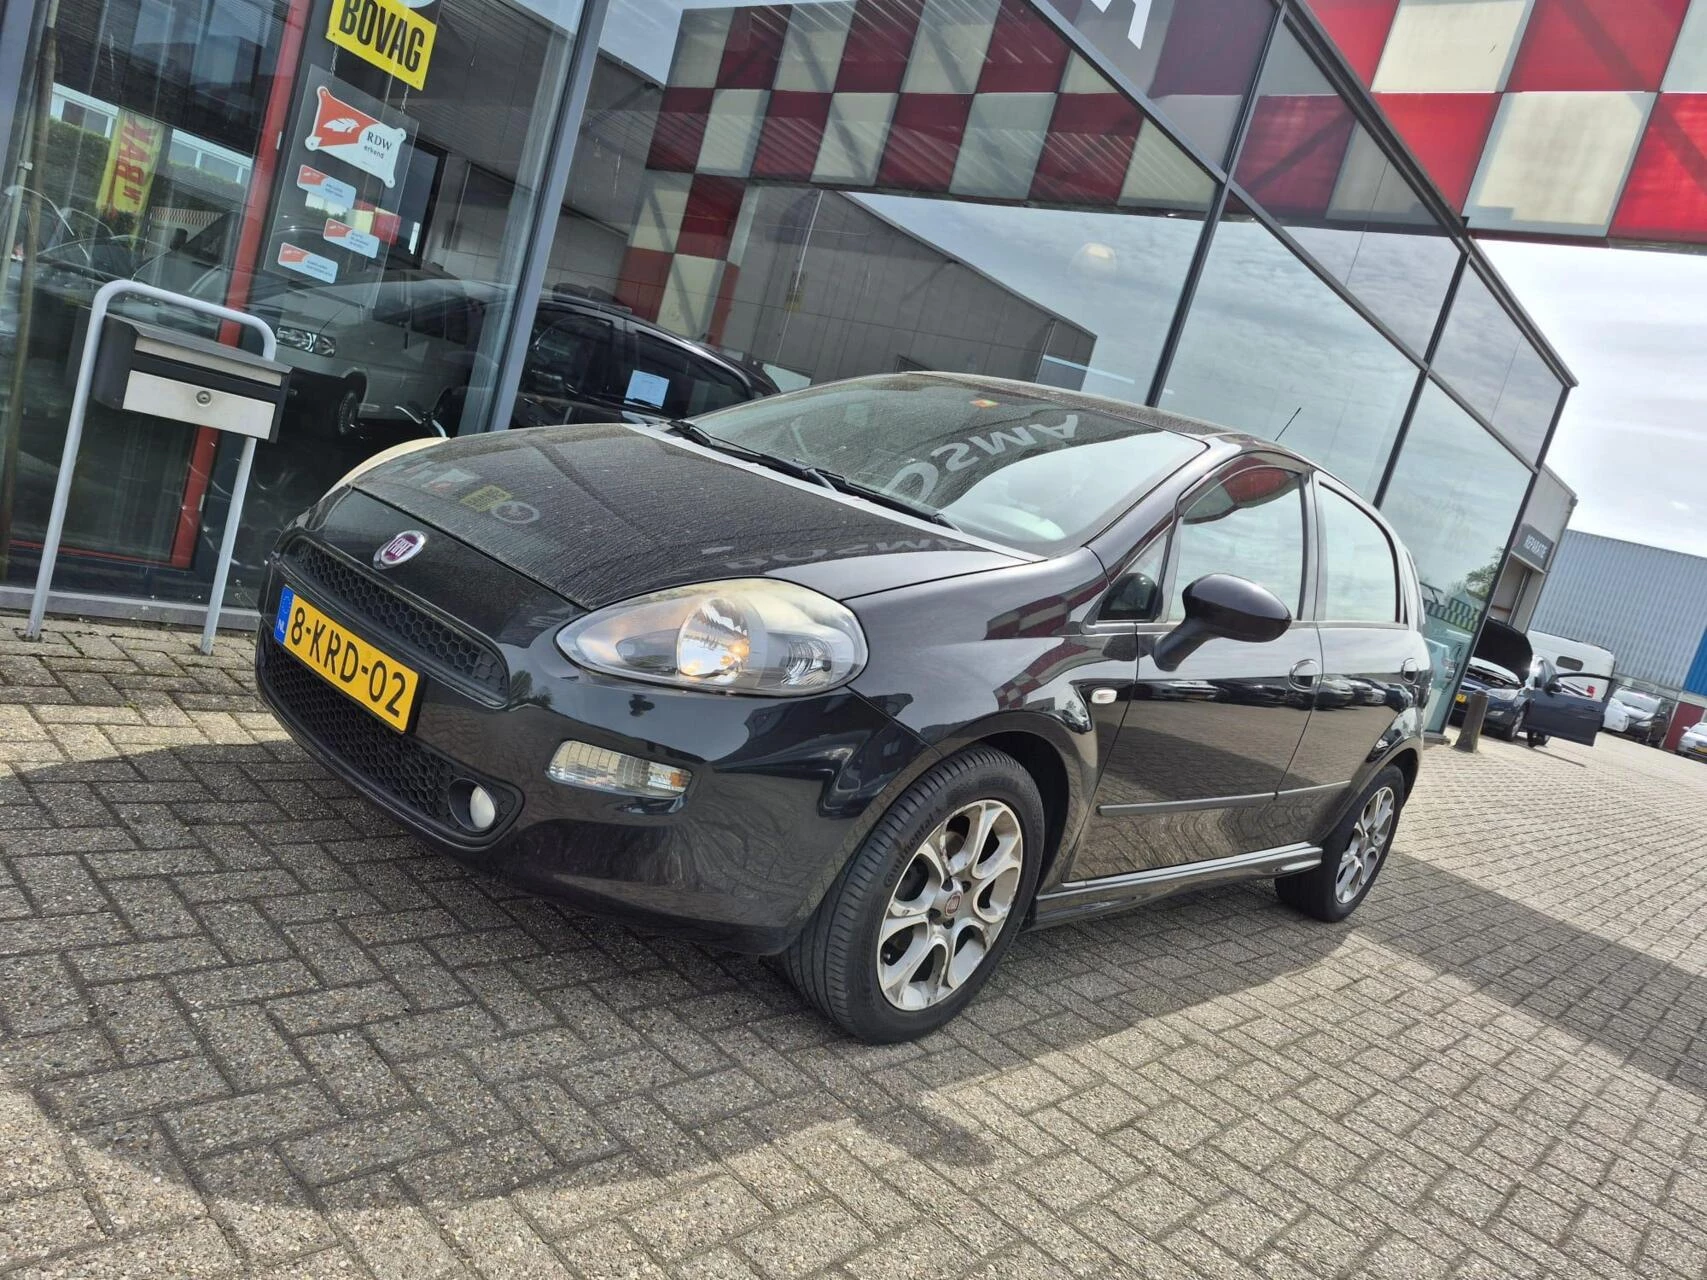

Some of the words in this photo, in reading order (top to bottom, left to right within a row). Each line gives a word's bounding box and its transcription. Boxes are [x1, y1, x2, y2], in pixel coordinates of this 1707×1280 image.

[339, 0, 425, 72] BOVAG
[367, 131, 393, 151] RDW
[364, 145, 385, 160] erkend
[387, 537, 415, 558] FIAT
[276, 618, 286, 634] NL
[291, 606, 406, 718] 8-KRD-02
